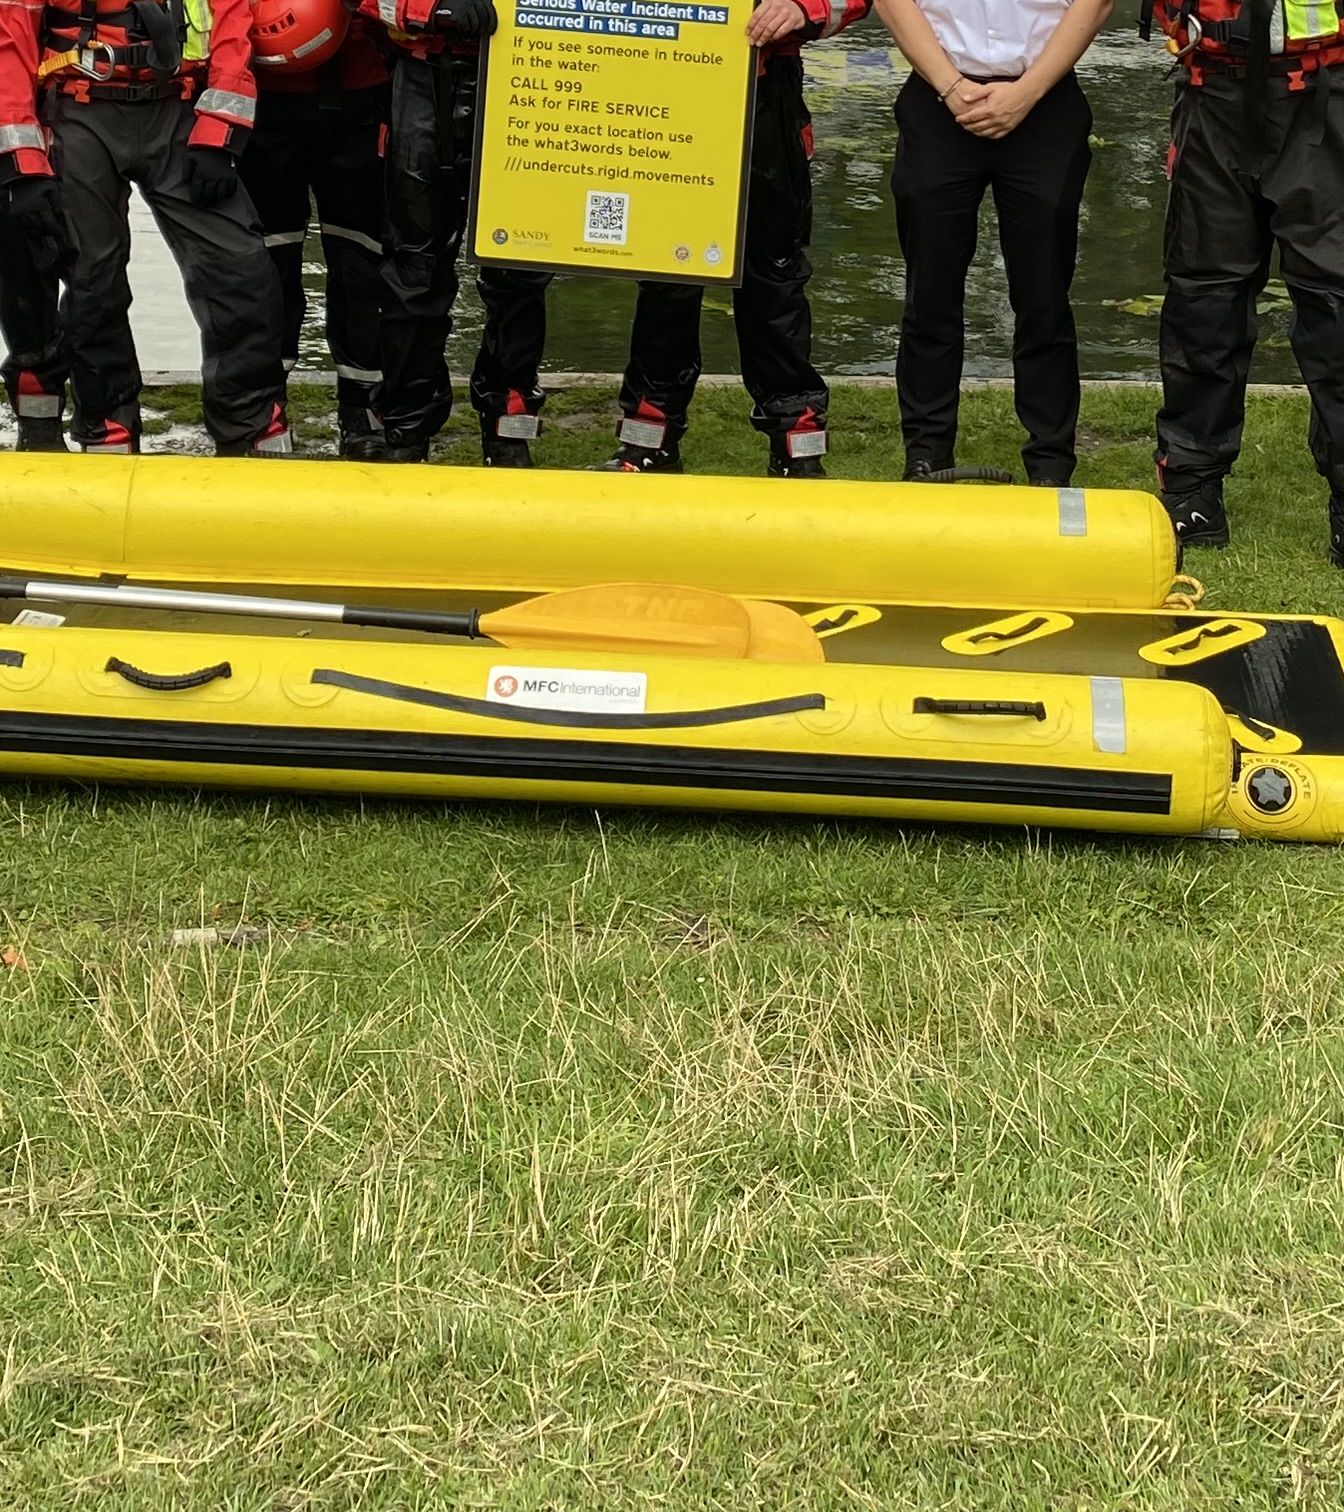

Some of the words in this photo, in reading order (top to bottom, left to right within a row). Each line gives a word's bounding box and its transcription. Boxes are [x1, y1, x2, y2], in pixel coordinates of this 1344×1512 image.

[631, 1, 693, 20] Incident
[698, 6, 726, 22] has
[517, 12, 584, 30] occurred
[588, 16, 603, 30] in
[608, 18, 637, 34] this
[642, 22, 675, 37] area
[511, 54, 525, 66] in
[530, 56, 553, 68] the
[513, 36, 524, 48] If
[528, 39, 553, 52] you
[558, 42, 581, 53] see
[587, 44, 650, 59] someone
[655, 48, 667, 61] in
[673, 51, 723, 65] trouble
[510, 76, 548, 91] CALL
[554, 79, 583, 94] 999
[509, 94, 536, 108] Ask
[542, 97, 562, 110] for
[568, 99, 600, 113] FIRE
[605, 102, 670, 119] SERVICE
[508, 117, 530, 129] For
[535, 120, 559, 133] you
[564, 123, 603, 137] exact
[607, 125, 664, 142] location
[668, 132, 693, 144] use
[506, 135, 529, 147] the
[534, 137, 623, 155] what3words
[628, 147, 672, 160] below.
[512, 229, 551, 241] SANDY
[611, 233, 622, 241] ME
